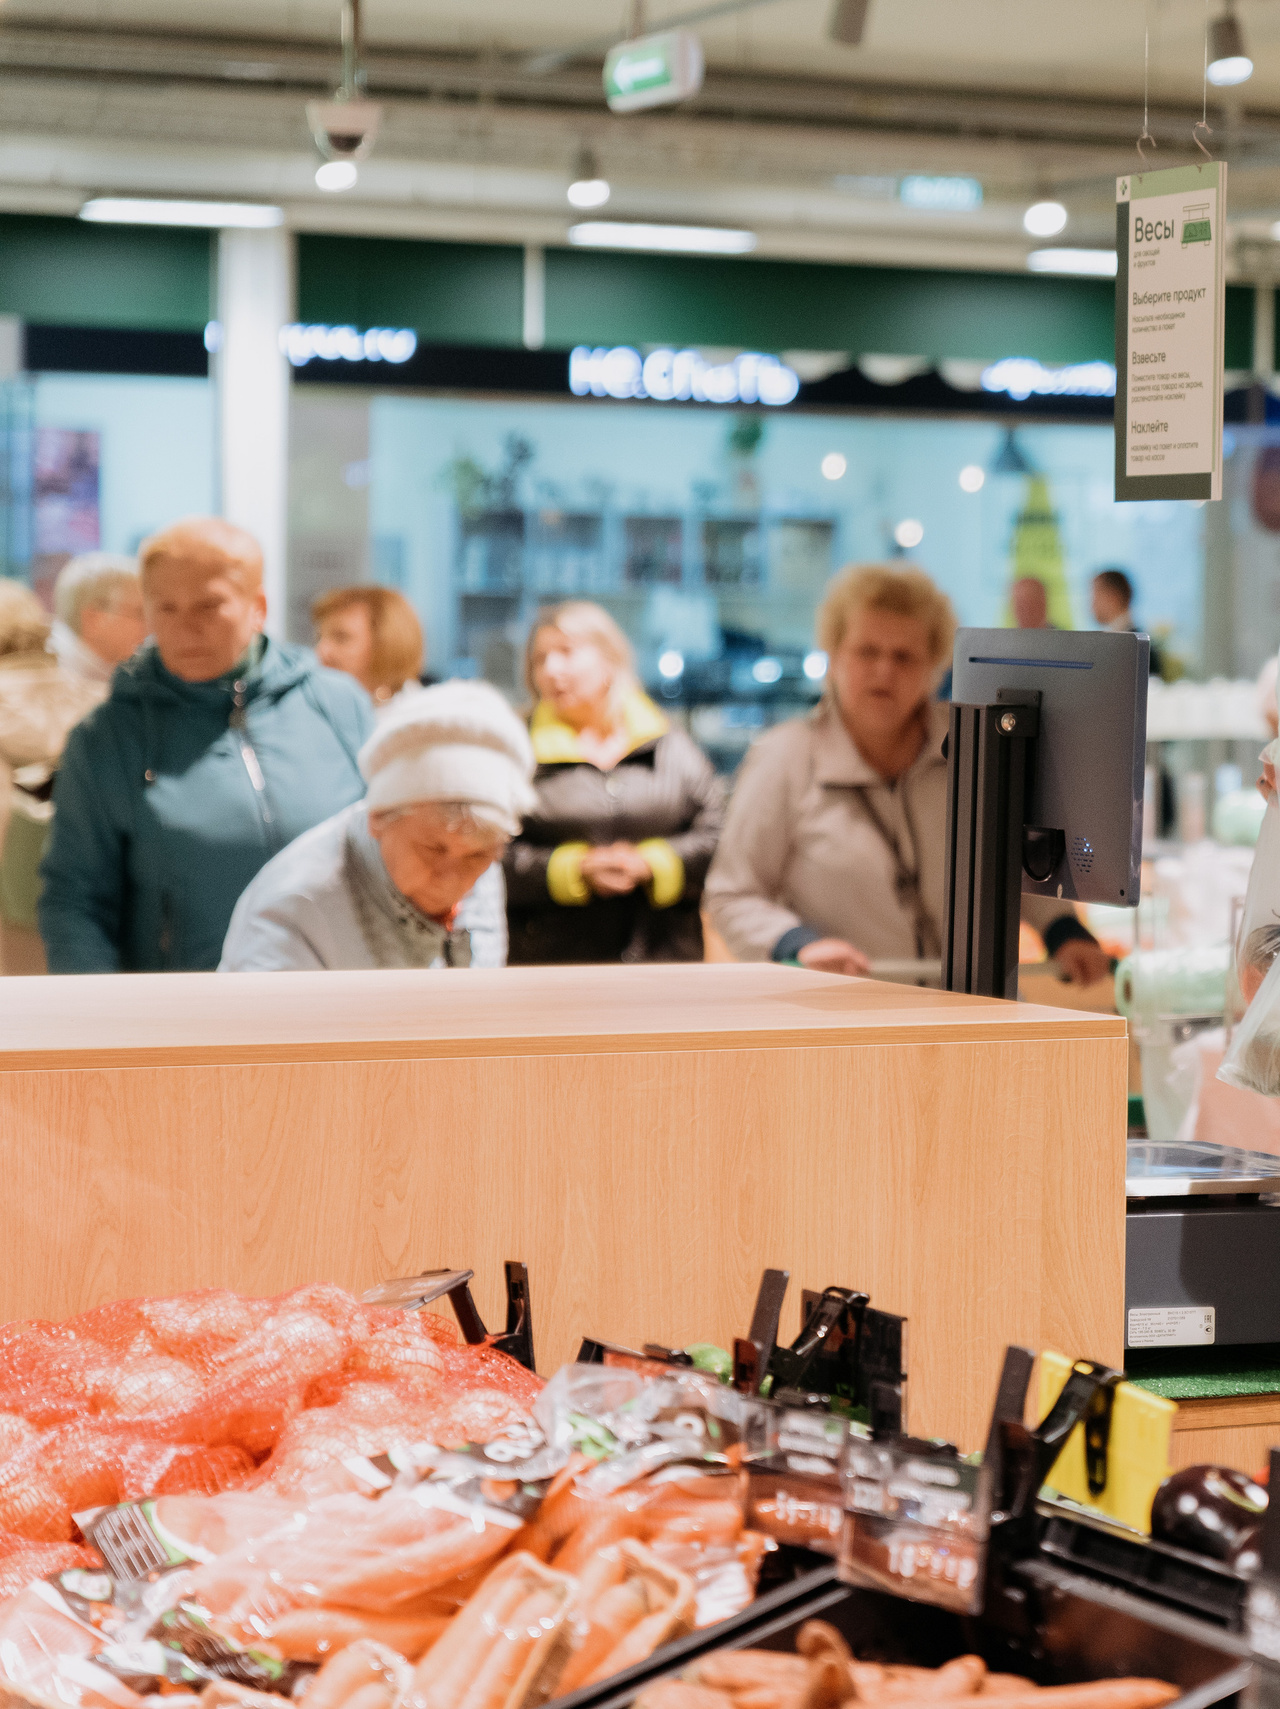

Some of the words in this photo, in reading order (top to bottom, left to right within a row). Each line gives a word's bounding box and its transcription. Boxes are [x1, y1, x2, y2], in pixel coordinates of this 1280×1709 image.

[1134, 216, 1175, 244] Весы
[1137, 260, 1156, 269] фруктов
[1133, 291, 1172, 307] Выберите
[1173, 288, 1206, 304] продукт
[1132, 351, 1166, 365] Взвесьте
[1156, 373, 1170, 381] товар
[1161, 383, 1178, 391] товара
[1164, 392, 1186, 402] наклейку
[1131, 420, 1168, 434] Наклейте
